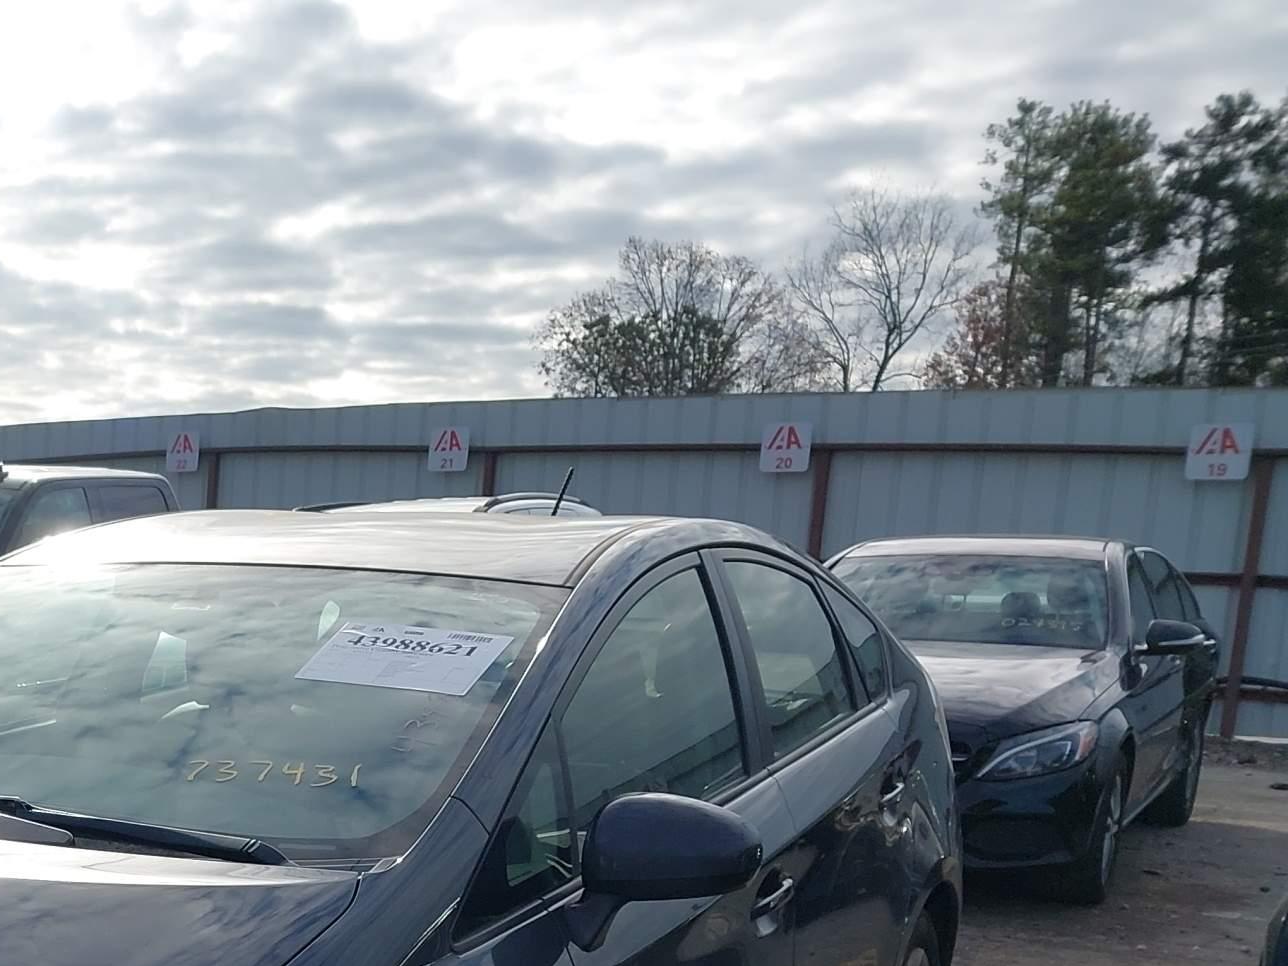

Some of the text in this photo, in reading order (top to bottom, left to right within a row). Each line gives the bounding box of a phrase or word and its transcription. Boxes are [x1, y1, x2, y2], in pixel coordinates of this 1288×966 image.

[441, 458, 454, 470] 21
[775, 457, 793, 469] 20
[1208, 463, 1228, 477] 19
[347, 634, 478, 657] 43988621
[186, 759, 363, 788] 737431
